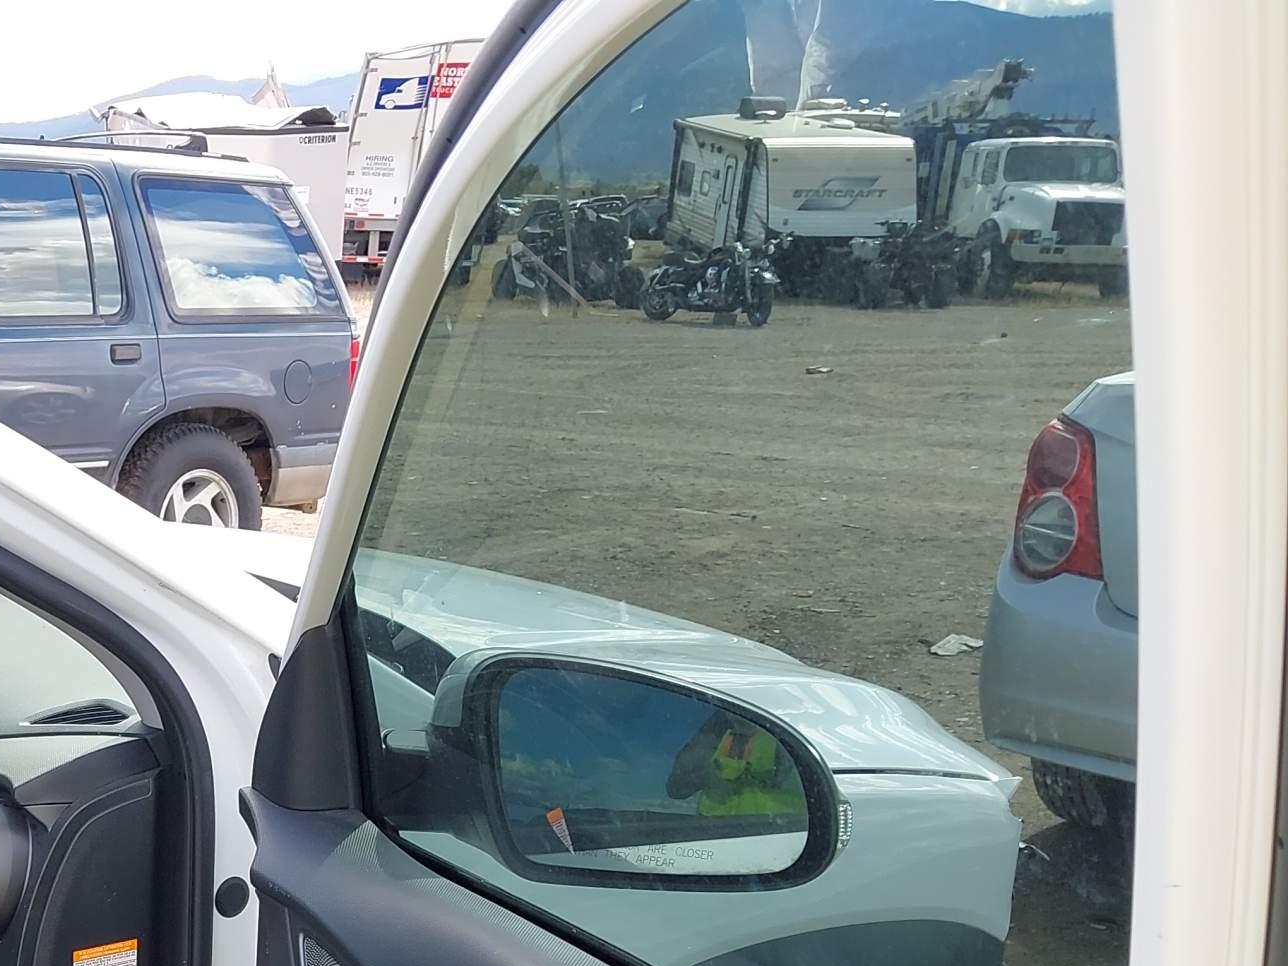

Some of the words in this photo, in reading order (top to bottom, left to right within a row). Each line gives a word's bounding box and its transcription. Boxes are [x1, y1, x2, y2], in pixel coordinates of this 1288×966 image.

[303, 135, 337, 145] CRITERION
[792, 188, 888, 198] STARCRAFT
[647, 844, 667, 855] ARE
[675, 846, 714, 861] CLOSER
[636, 854, 676, 868] APPEAR
